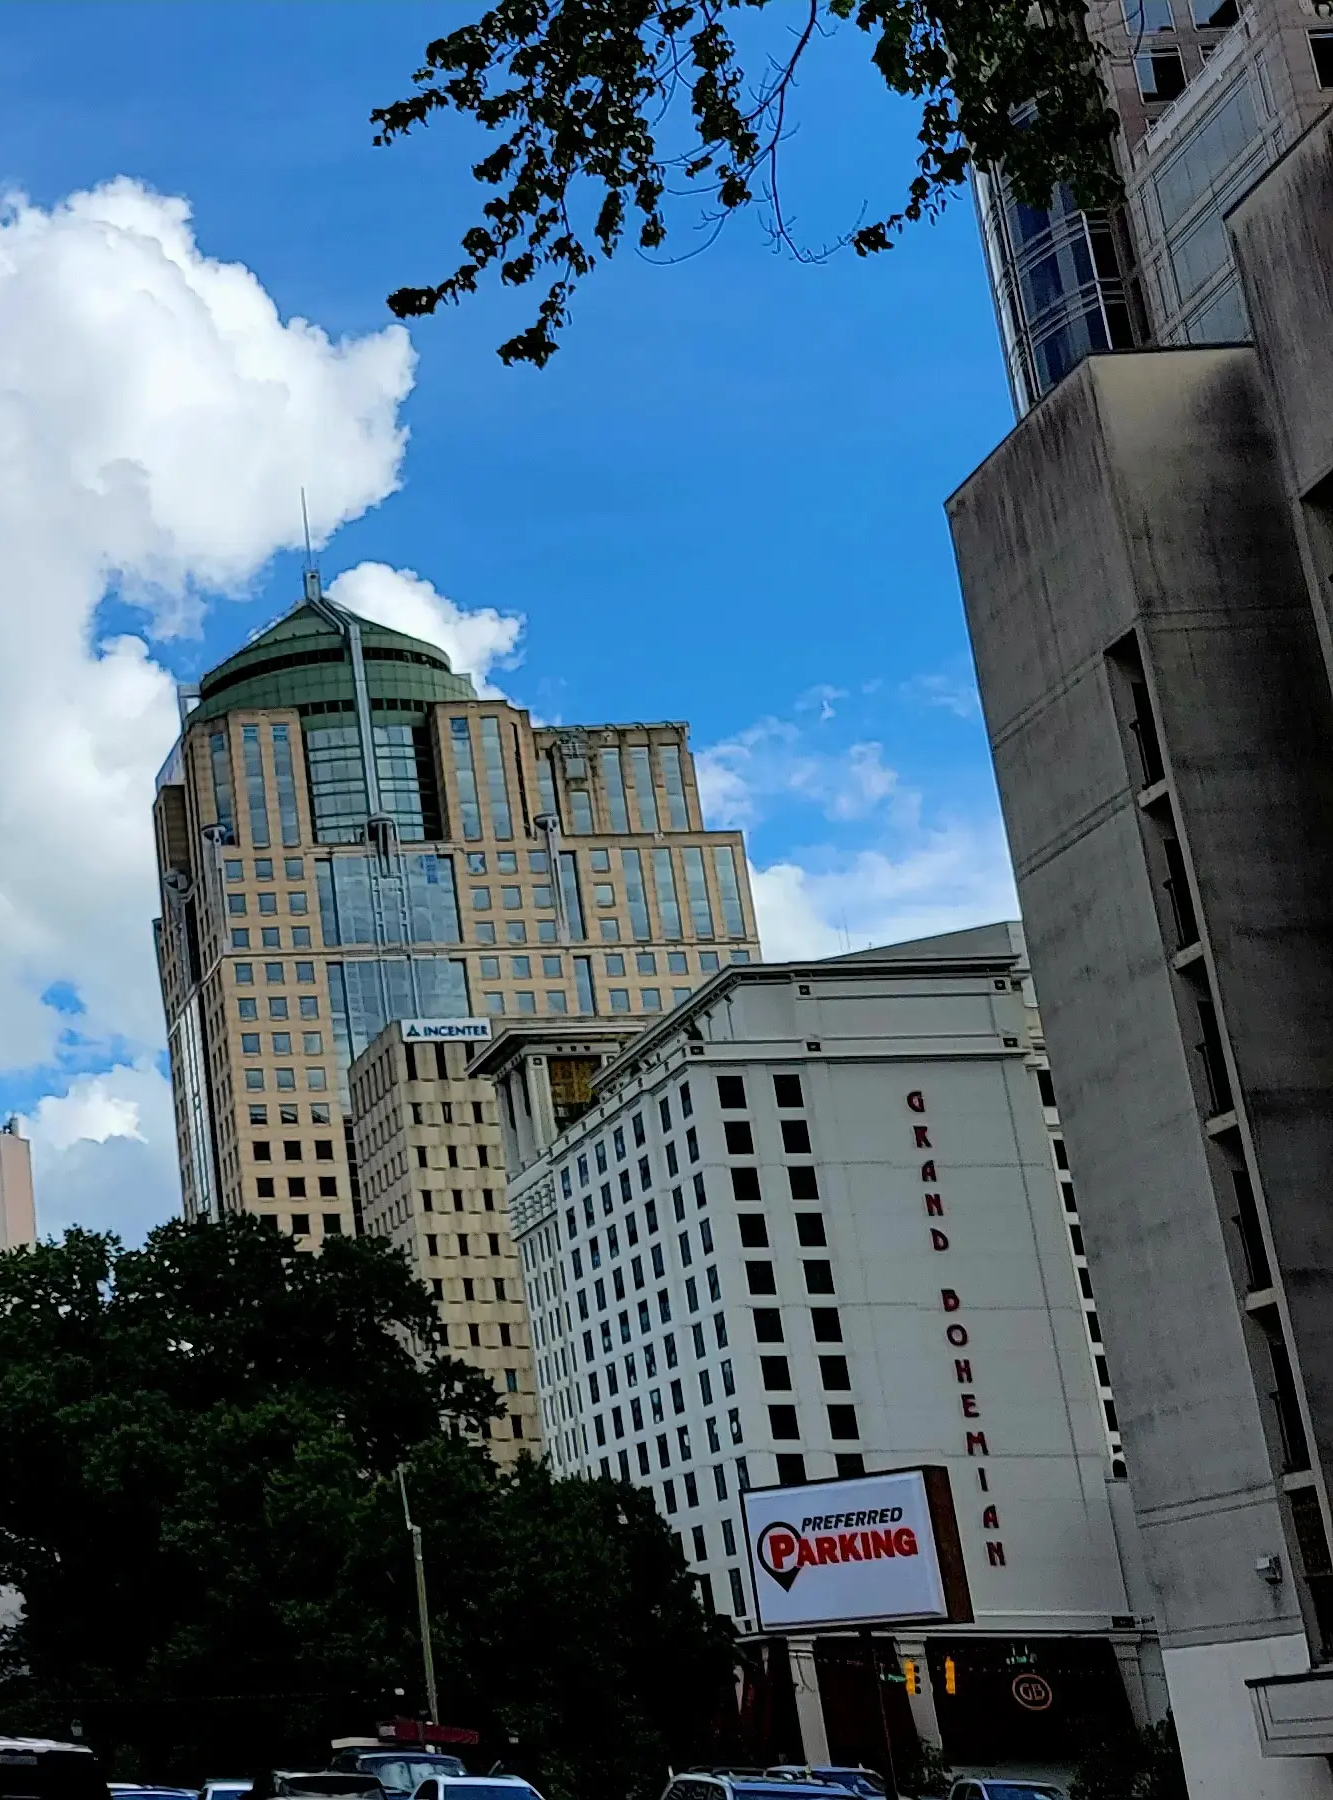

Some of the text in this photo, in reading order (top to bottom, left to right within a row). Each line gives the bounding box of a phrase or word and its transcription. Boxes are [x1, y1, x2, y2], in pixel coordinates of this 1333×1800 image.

[423, 1025, 488, 1036] INCENTER
[906, 1090, 1007, 1567] GRAND BOHEMIAN
[801, 1506, 903, 1533] PREFERRED
[769, 1527, 918, 1570] PARKING
